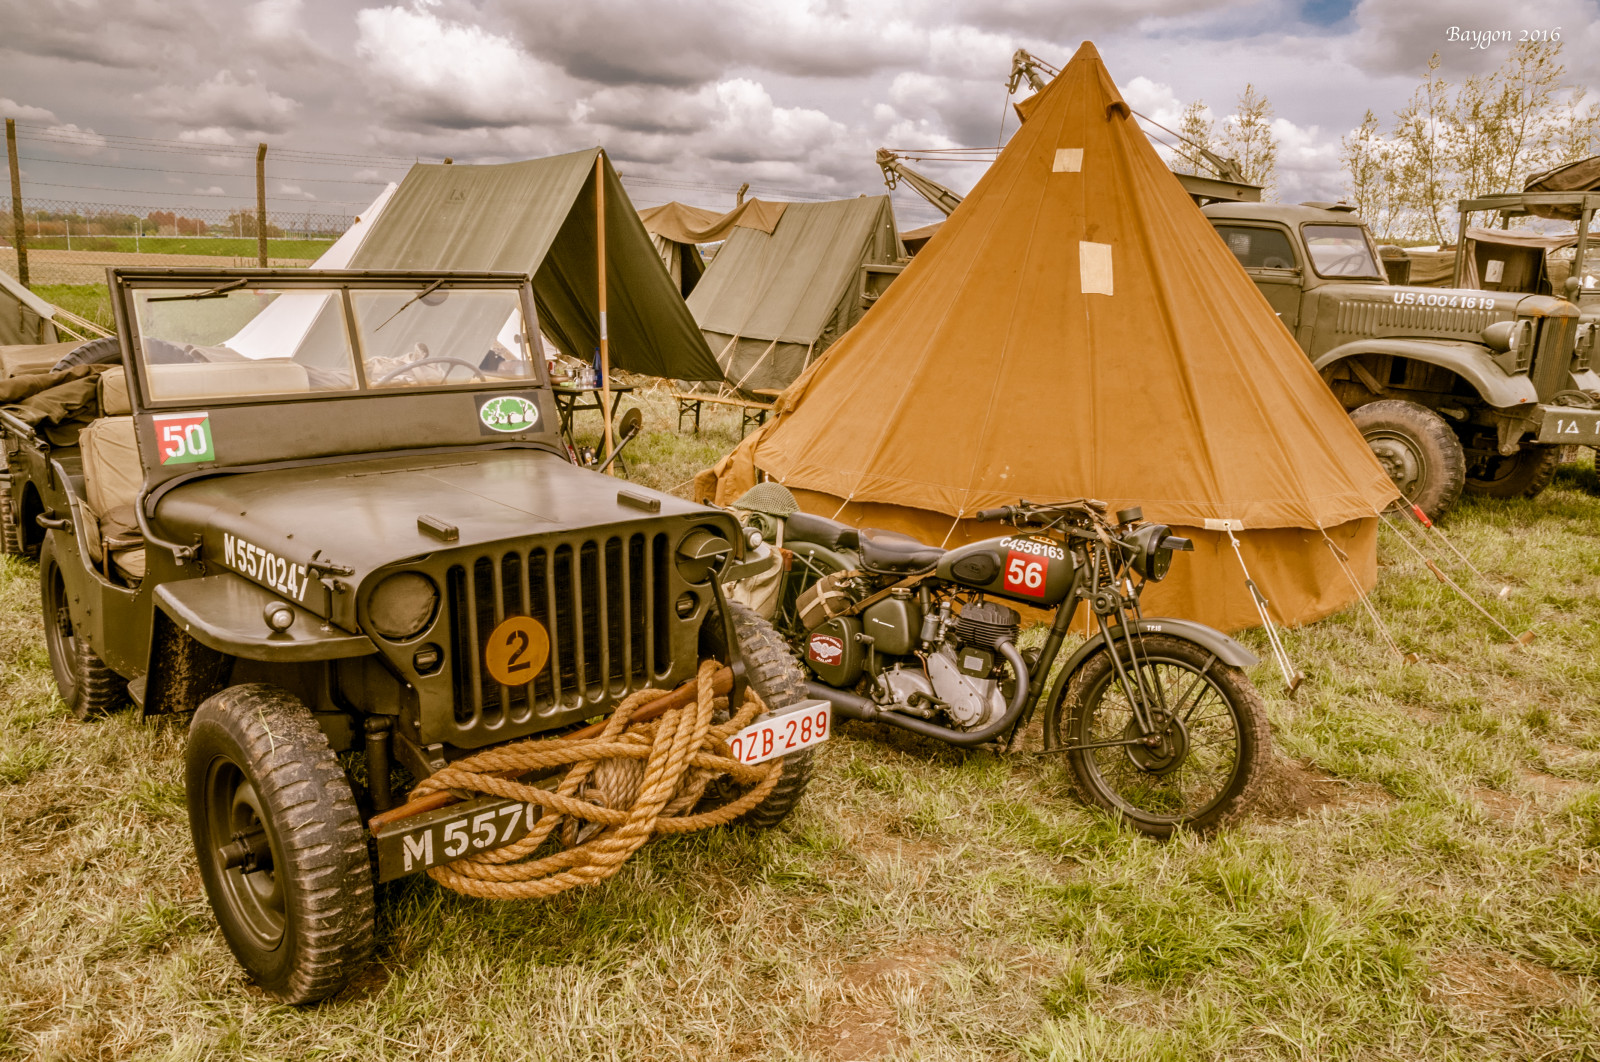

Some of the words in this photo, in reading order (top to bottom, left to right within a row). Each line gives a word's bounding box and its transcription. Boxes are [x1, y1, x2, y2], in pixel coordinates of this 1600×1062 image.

[1393, 292, 1495, 310] USA0041619
[163, 423, 207, 457] 50
[1000, 537, 1064, 560] C4558163
[1007, 558, 1043, 588] 56
[505, 629, 531, 674] 2
